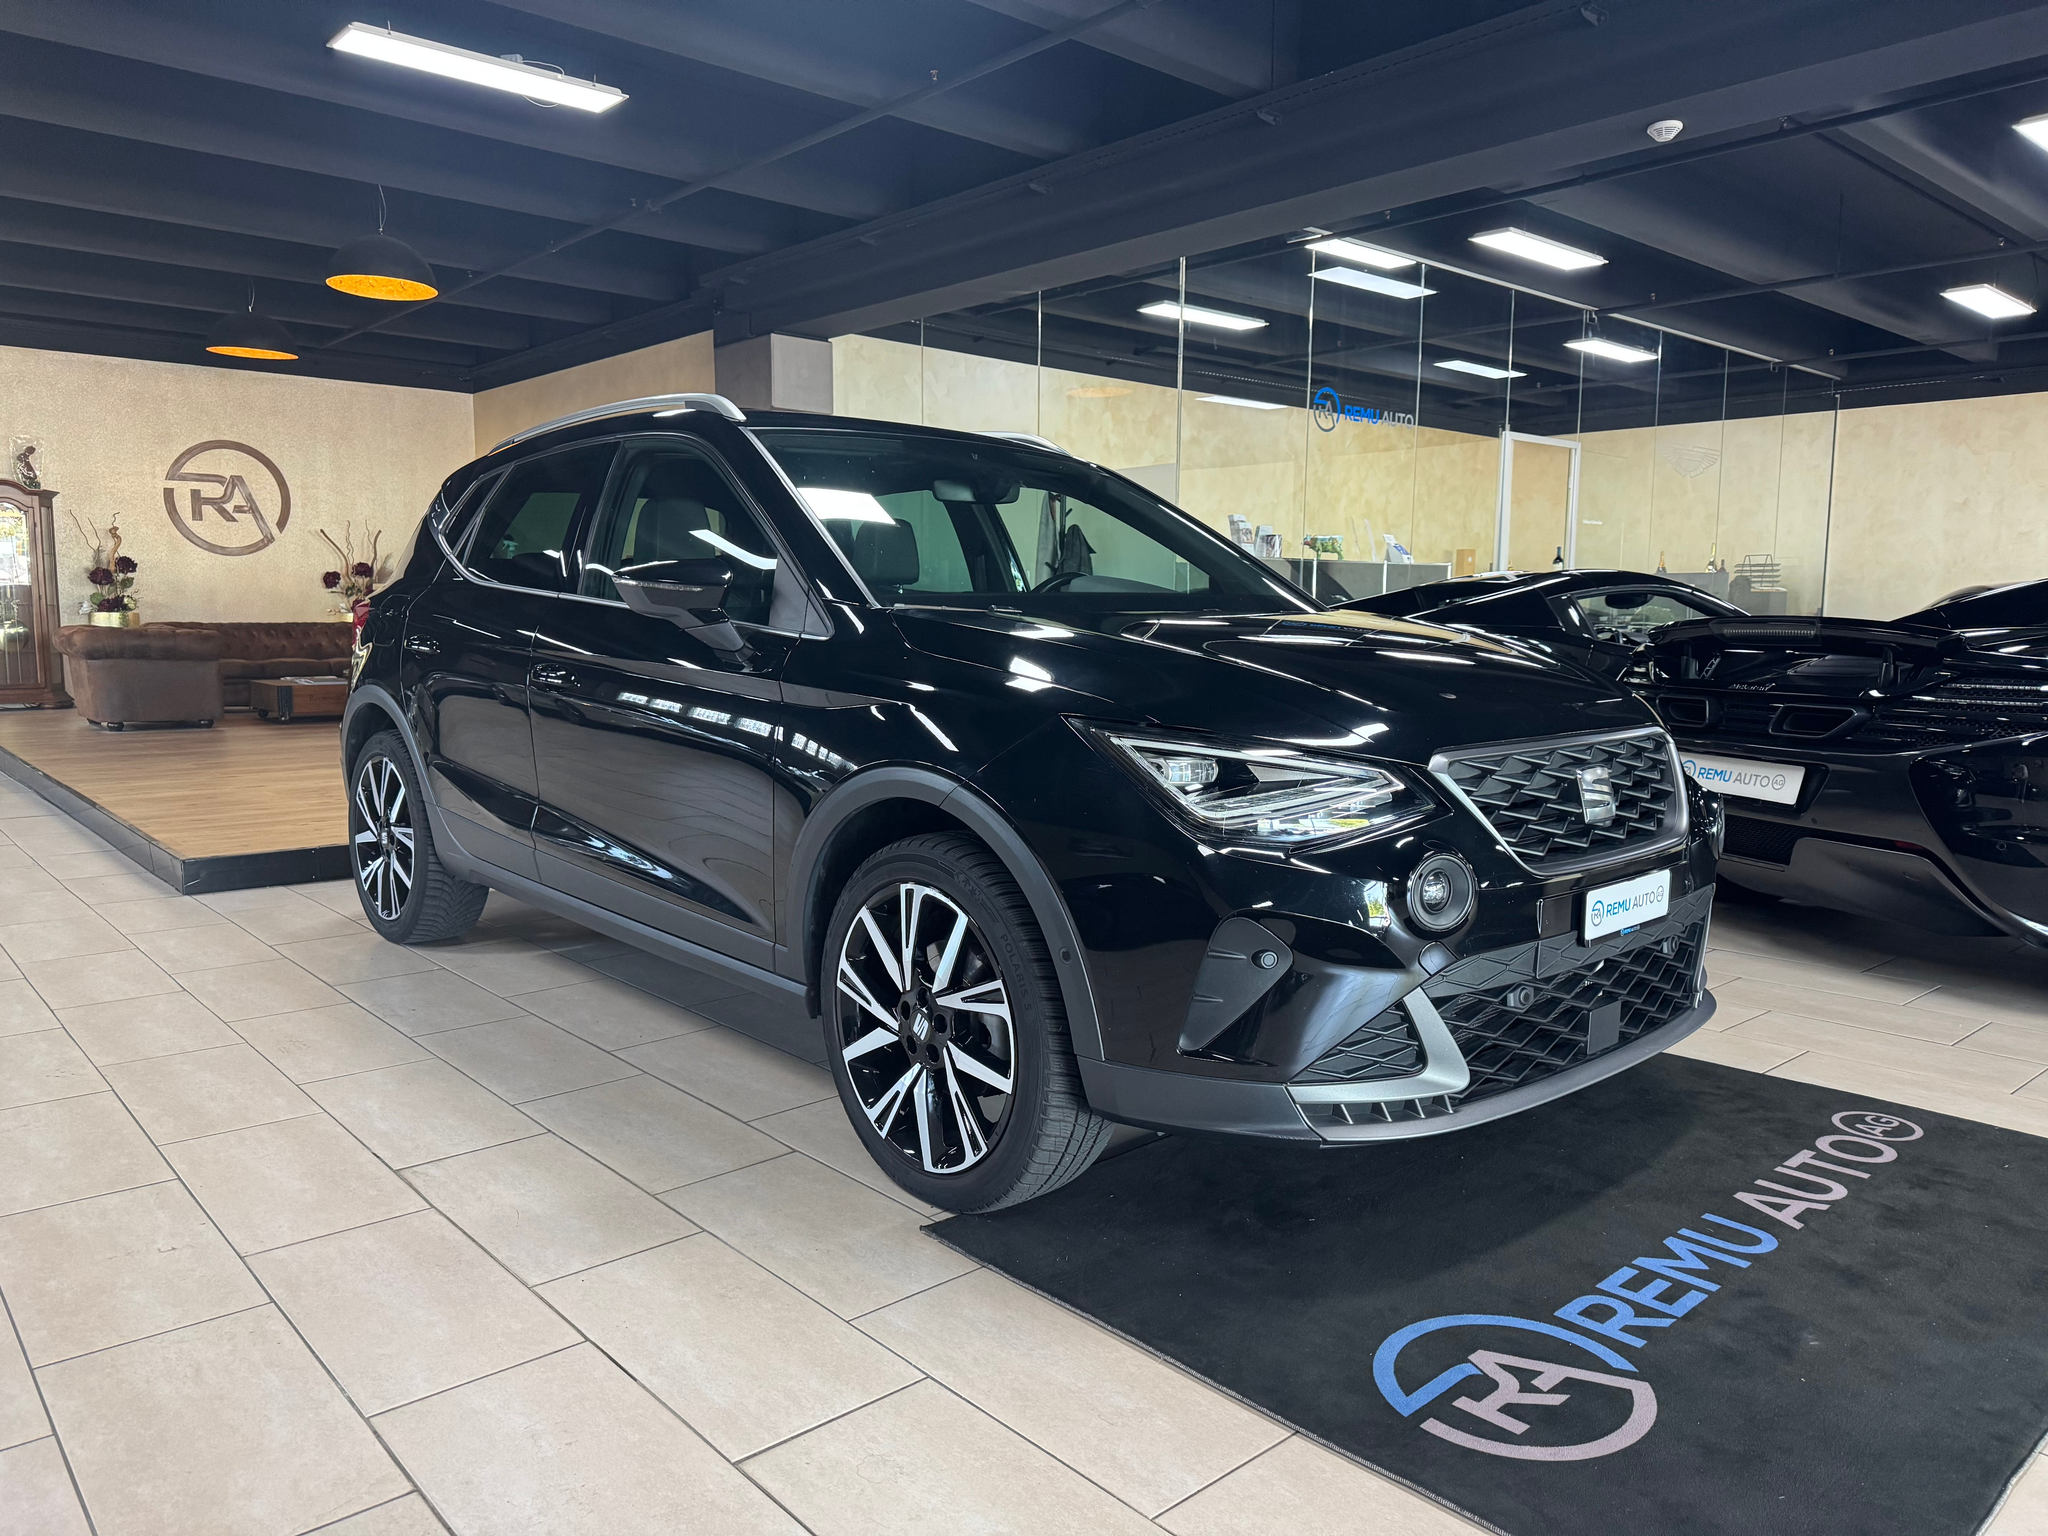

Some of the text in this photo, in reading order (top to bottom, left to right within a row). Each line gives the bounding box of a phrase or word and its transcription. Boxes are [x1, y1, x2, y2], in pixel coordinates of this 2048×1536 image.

[1344, 405, 1414, 429] REMU AUTO
[1697, 766, 1733, 783] REMU
[1732, 772, 1771, 788] AUTO
[1605, 897, 1632, 918] REMU
[1632, 890, 1656, 910] AUTO
[1000, 933, 1032, 1011] POLARIS 5
[1553, 1114, 1900, 1348] REMU AUTO AG
